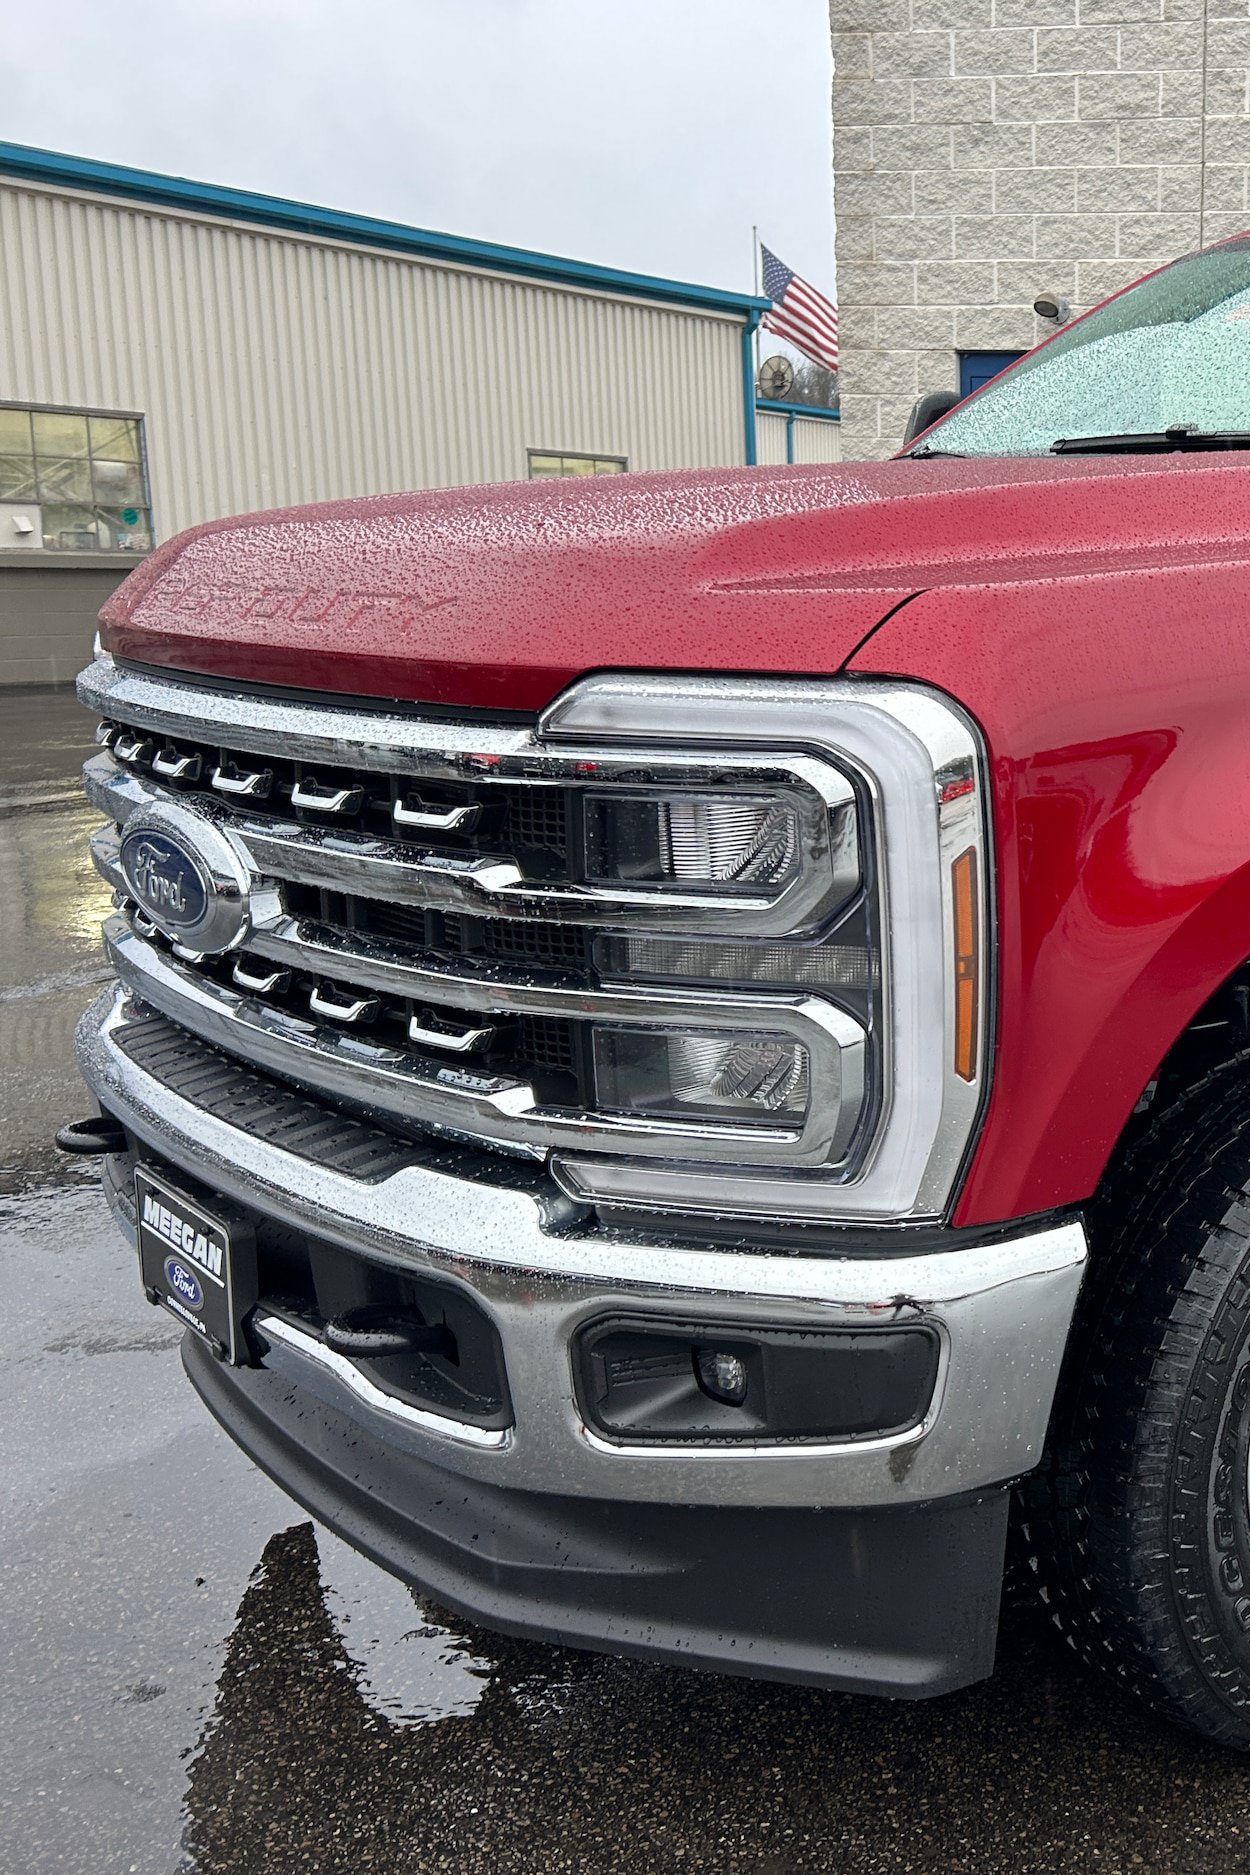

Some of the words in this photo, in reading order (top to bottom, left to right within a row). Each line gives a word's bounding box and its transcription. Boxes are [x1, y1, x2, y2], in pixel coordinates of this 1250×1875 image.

[134, 841, 187, 912] Ford
[143, 1194, 223, 1276] MEEGAN
[173, 1265, 196, 1300] Ford
